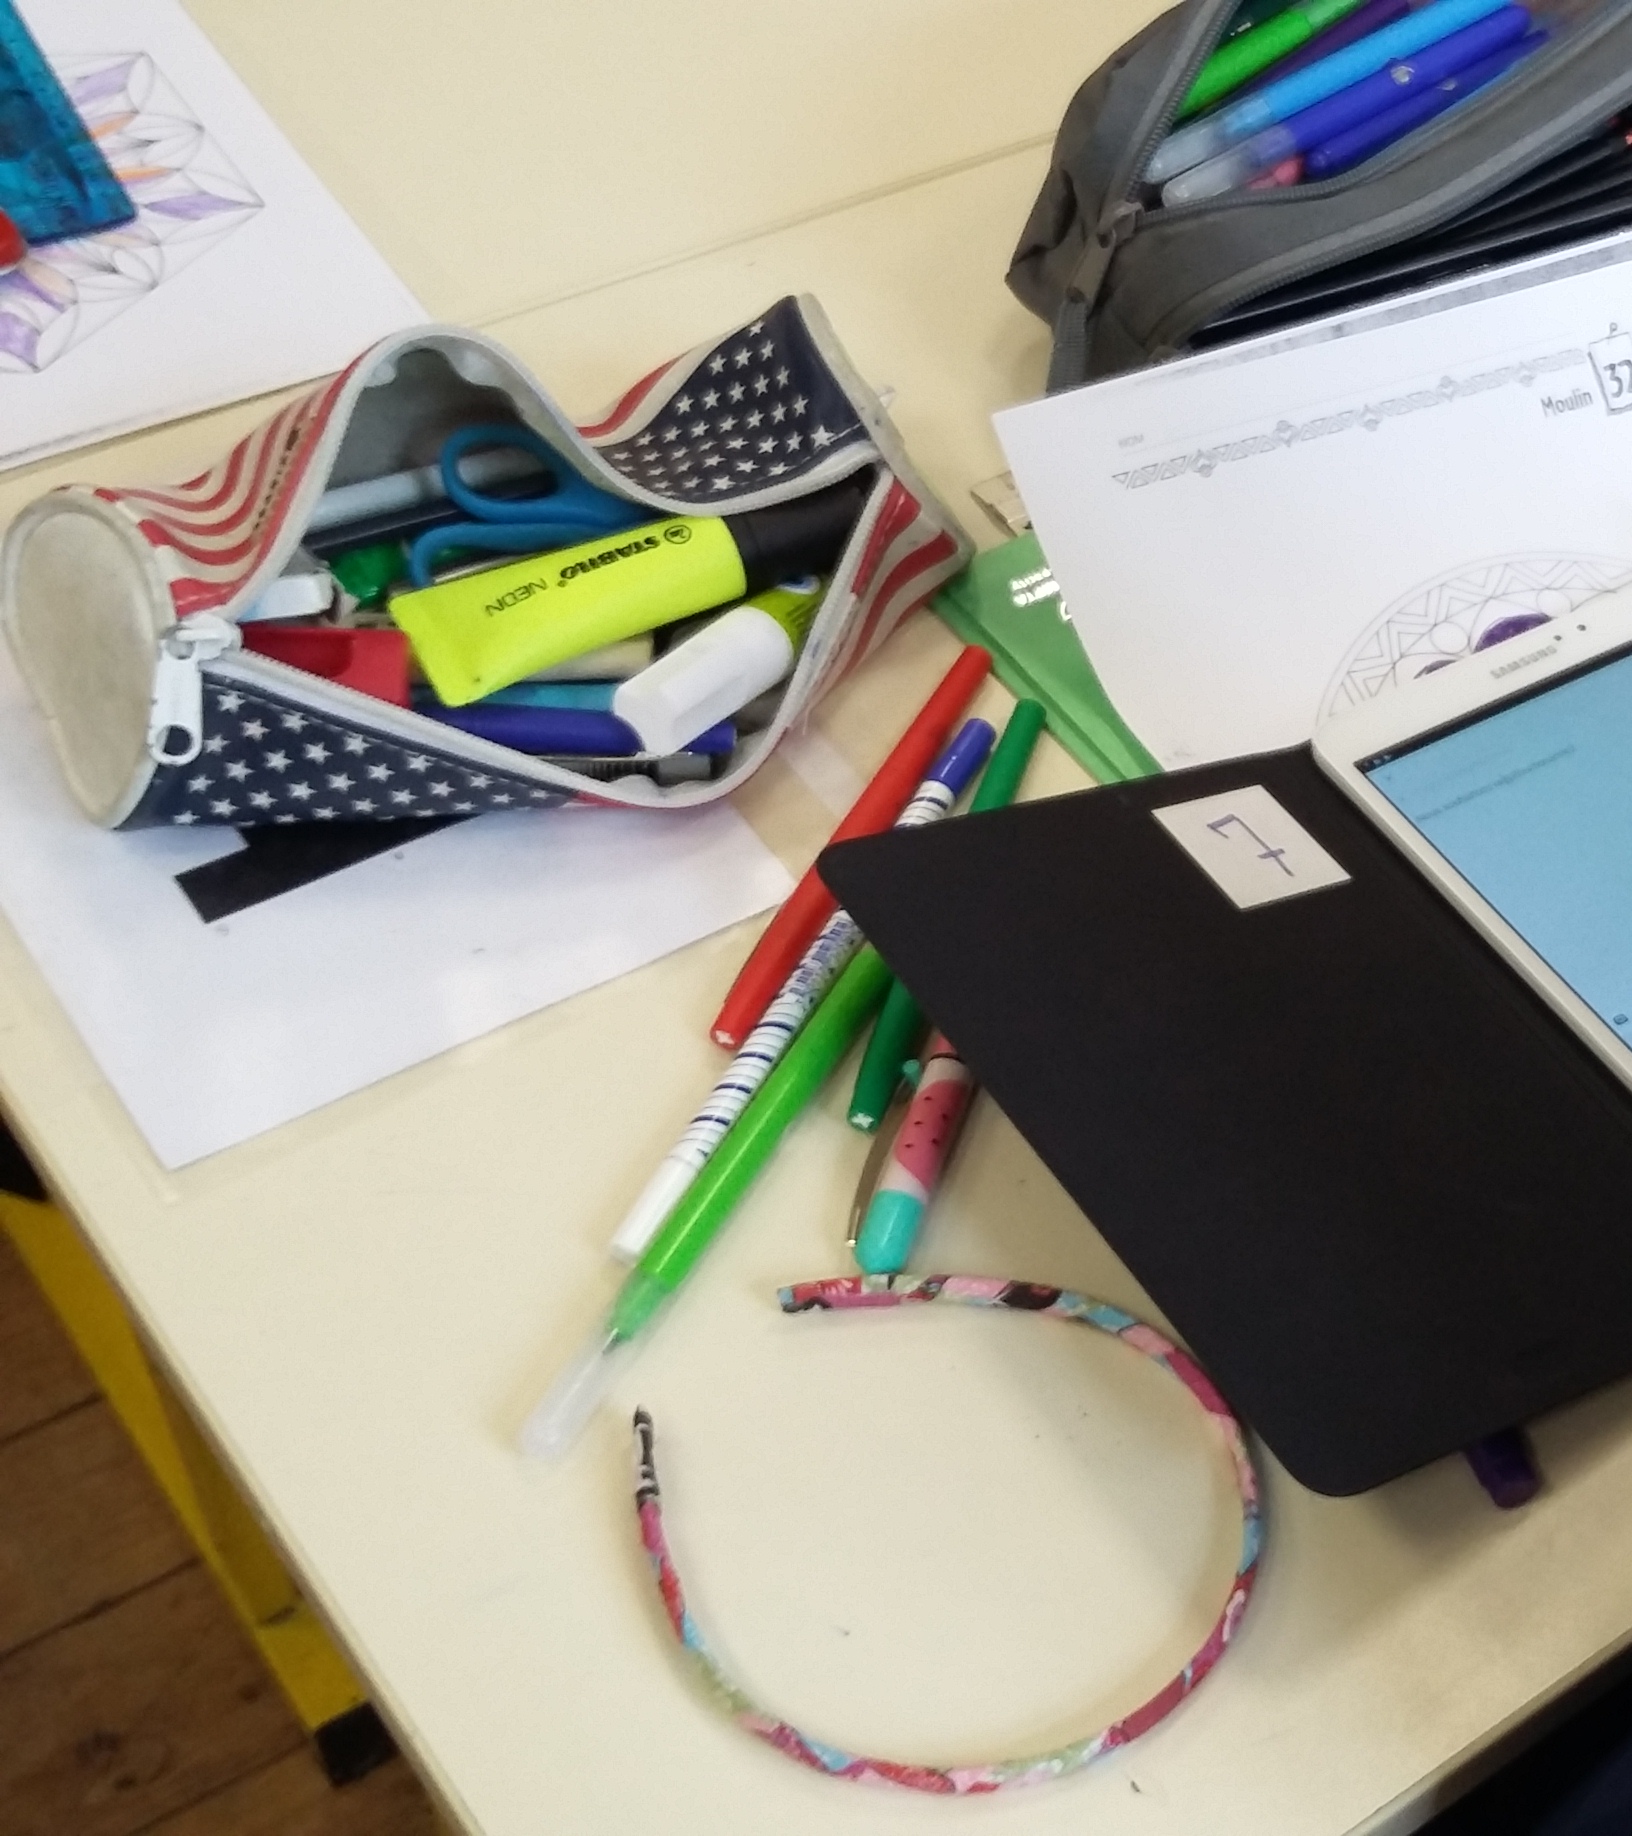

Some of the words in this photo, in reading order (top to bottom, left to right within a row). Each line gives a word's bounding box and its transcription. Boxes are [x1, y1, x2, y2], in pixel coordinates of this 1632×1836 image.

[1540, 388, 1594, 417] Moulin
[560, 535, 661, 580] STABILO
[484, 577, 549, 618] NEON
[1489, 644, 1558, 680] SAMSUNG
[1206, 813, 1295, 877] 7
